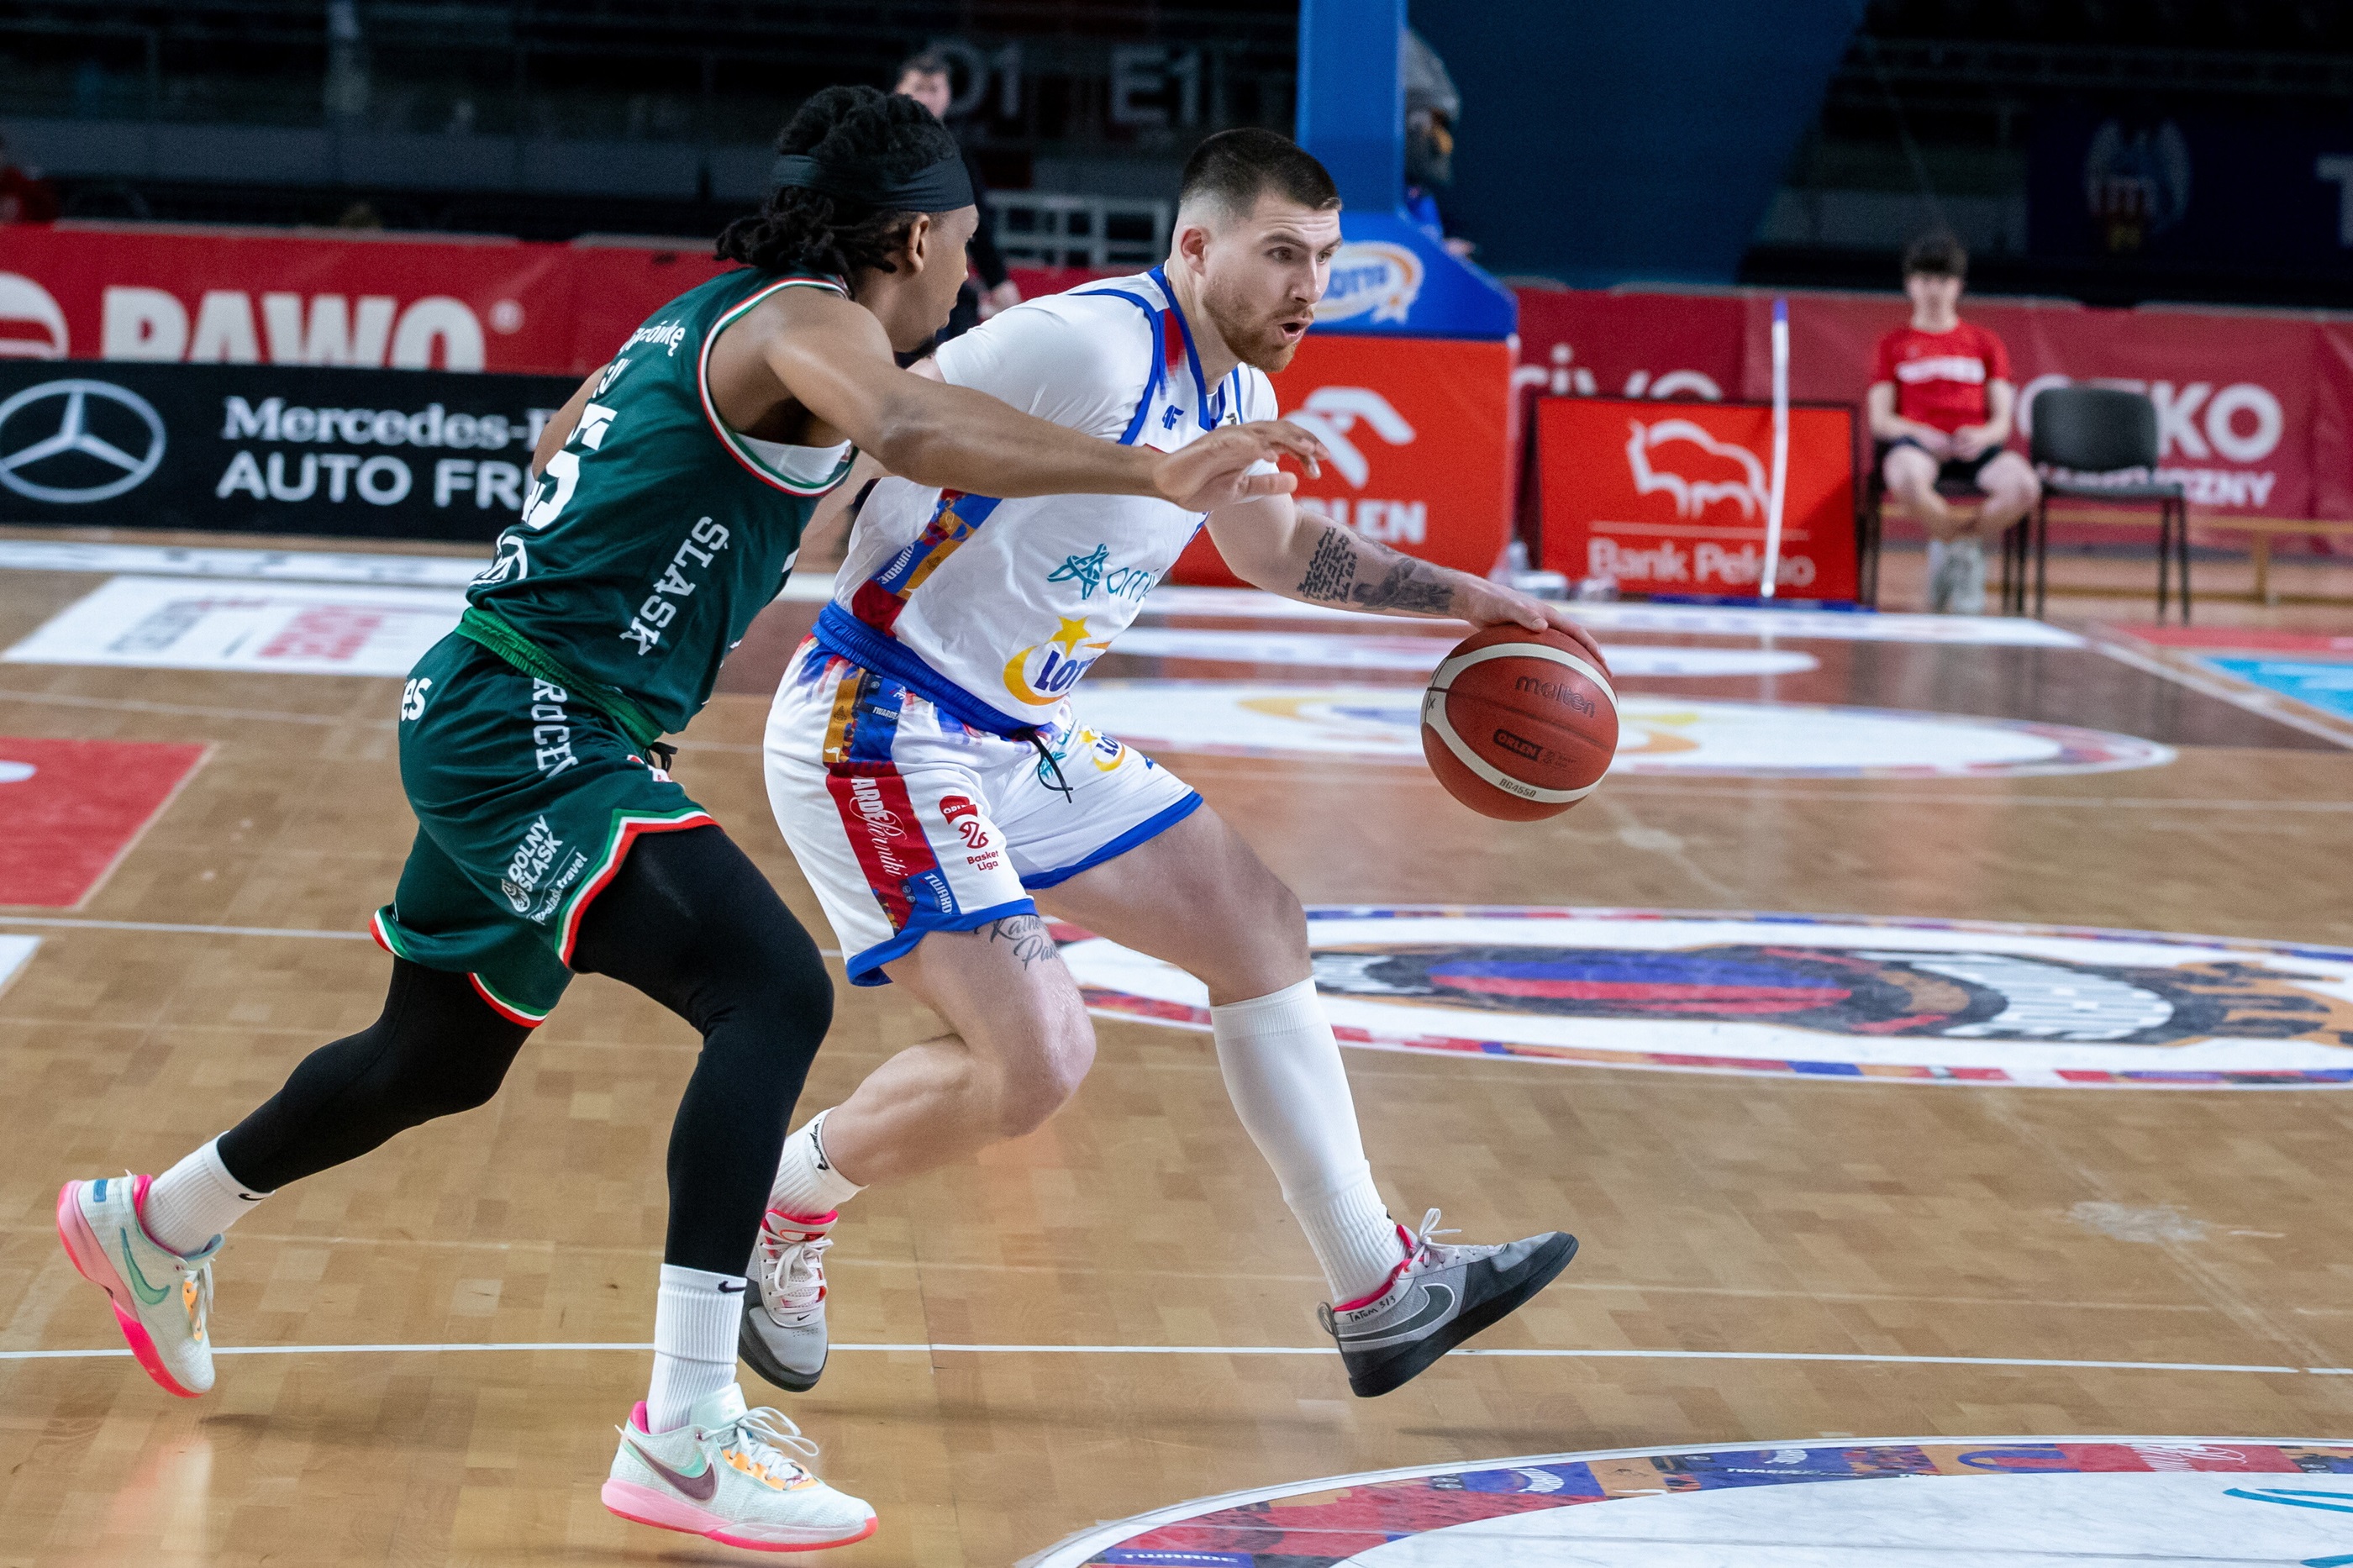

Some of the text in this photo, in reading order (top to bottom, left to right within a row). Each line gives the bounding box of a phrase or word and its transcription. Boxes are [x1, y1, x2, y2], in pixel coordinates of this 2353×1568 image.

[216, 451, 534, 510] AUTO FR
[1587, 538, 1690, 581] Bank
[1515, 675, 1596, 718] molten
[850, 776, 890, 823] ARDE
[1498, 778, 1537, 797] BG4550
[508, 814, 550, 882] DOLNY
[966, 850, 999, 865] Basket
[977, 860, 999, 871] Liga
[924, 872, 953, 915] TWARD
